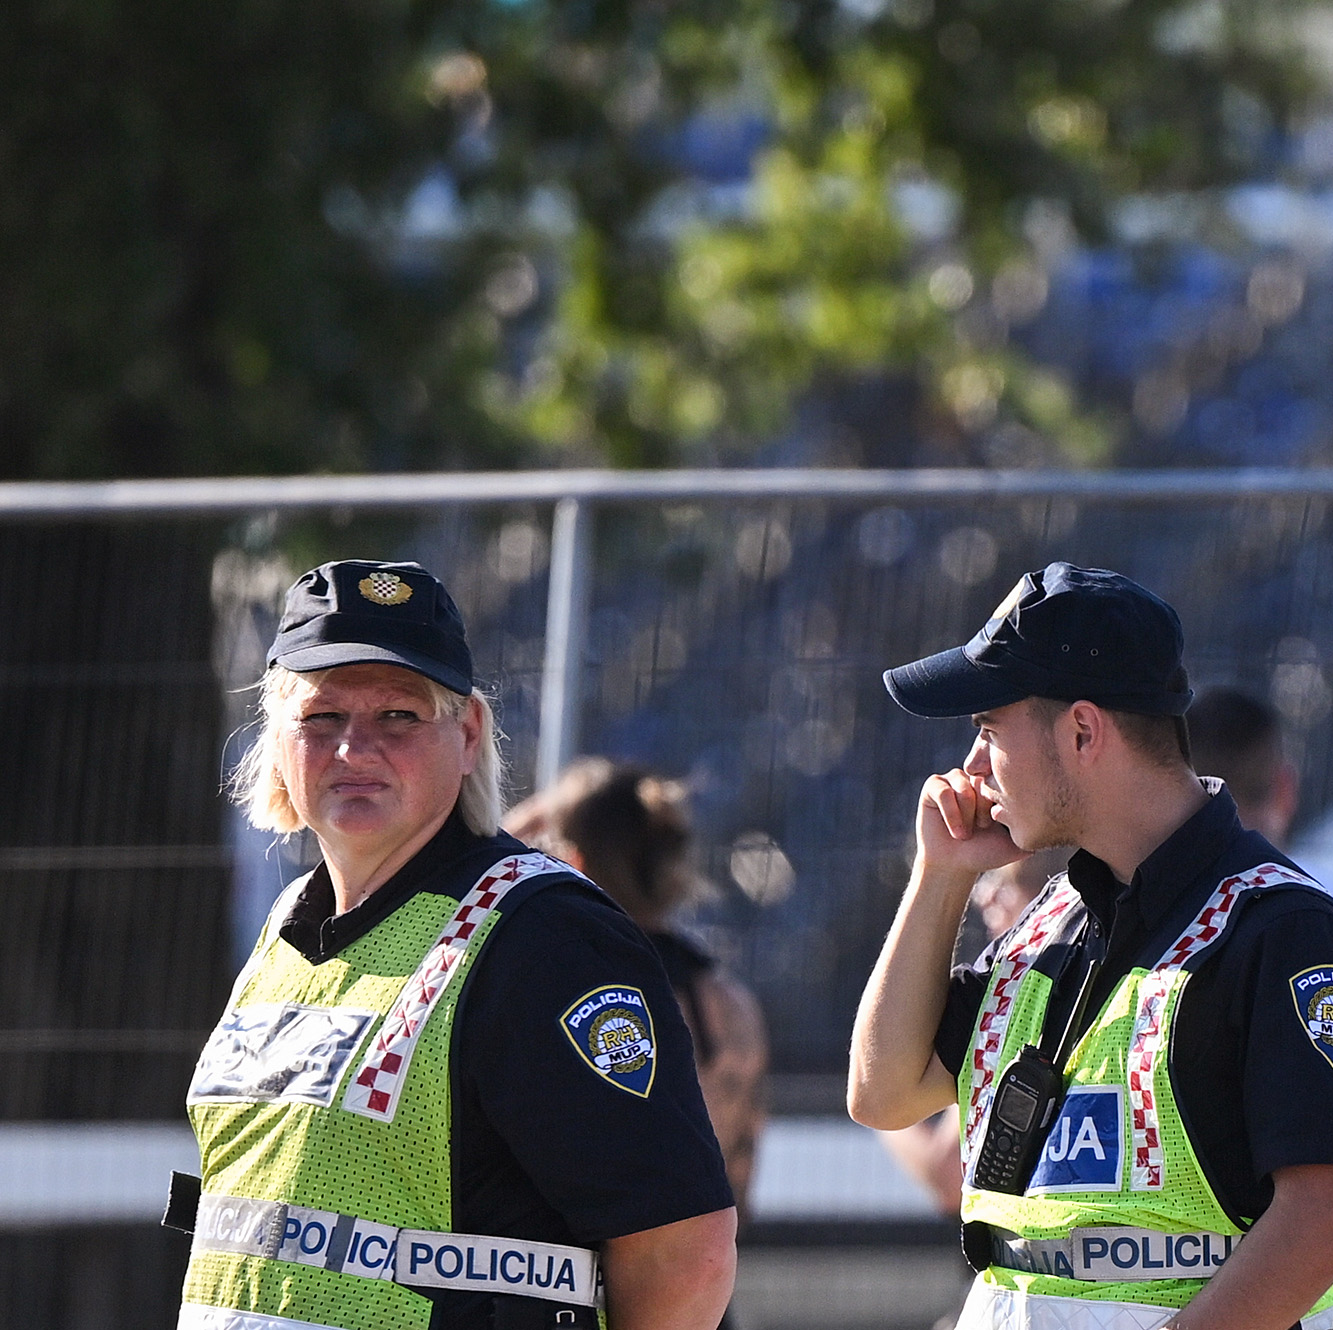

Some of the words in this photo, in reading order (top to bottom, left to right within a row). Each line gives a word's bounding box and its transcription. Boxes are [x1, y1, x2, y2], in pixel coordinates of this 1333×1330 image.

[568, 991, 643, 1029] POLICIJA
[602, 1025, 635, 1051] RH
[608, 1044, 641, 1062] MUP
[409, 1241, 576, 1292] POLICIJA
[1082, 1234, 1246, 1269] POLICIJ
